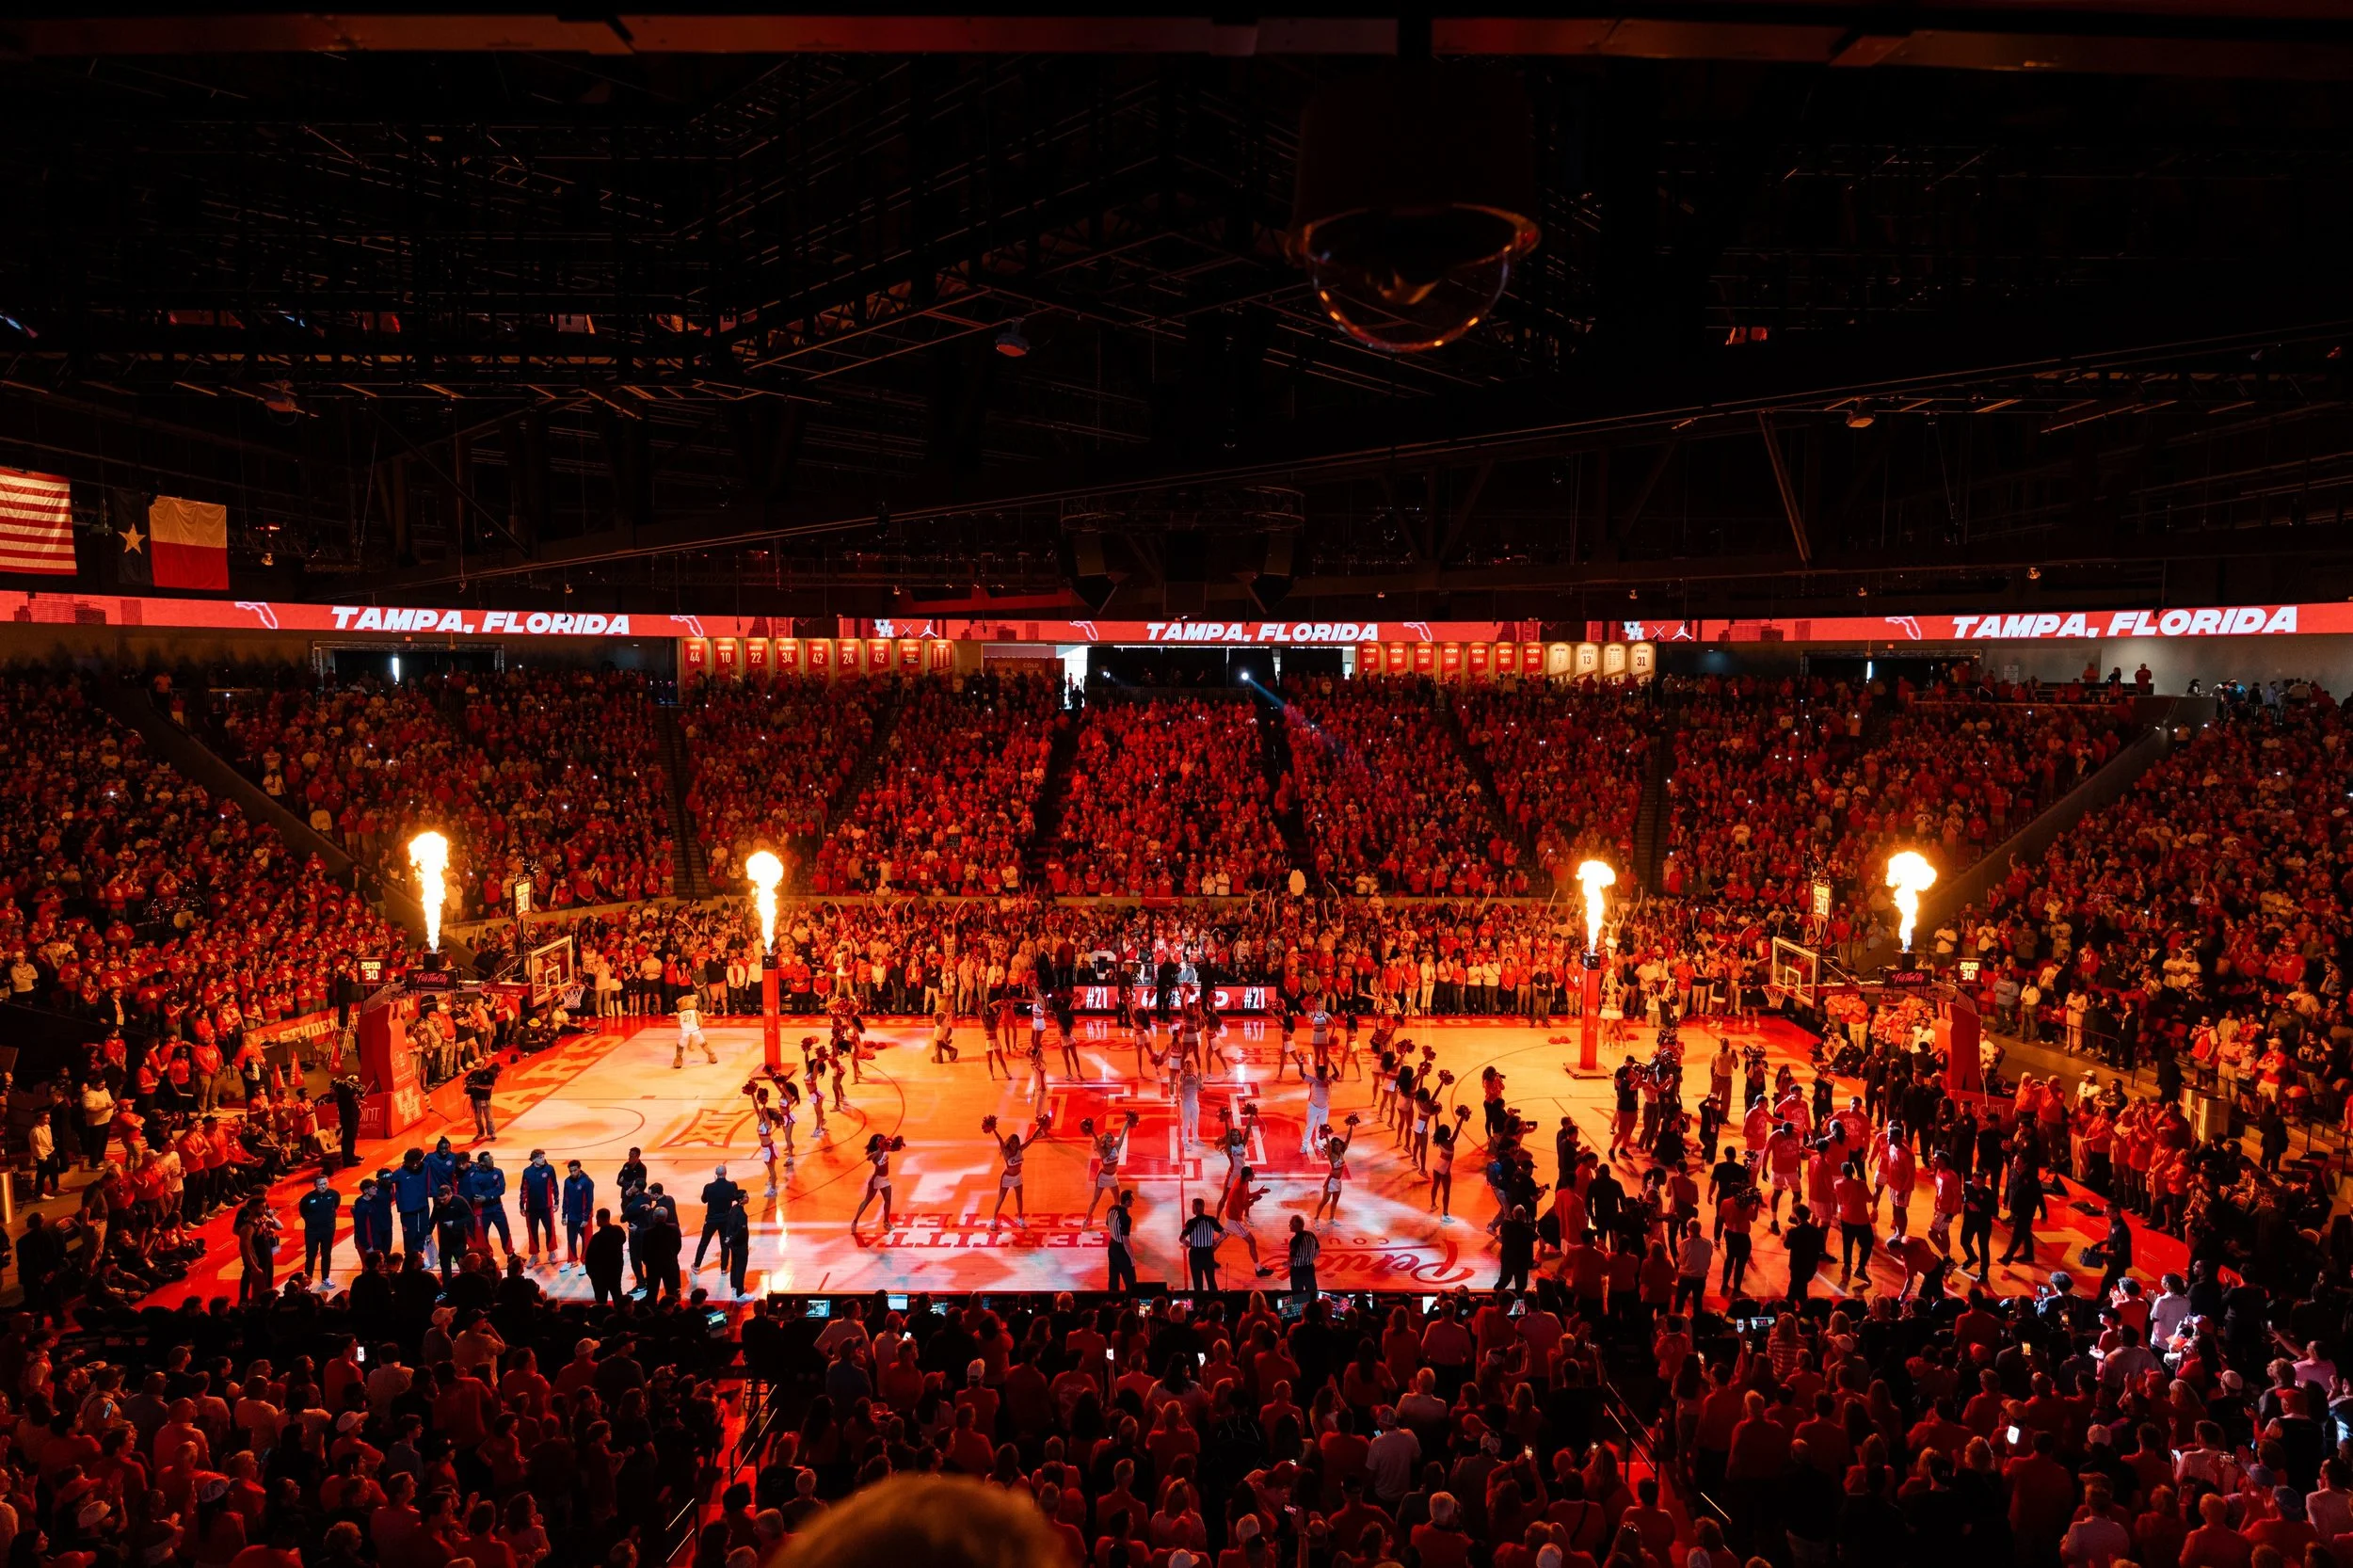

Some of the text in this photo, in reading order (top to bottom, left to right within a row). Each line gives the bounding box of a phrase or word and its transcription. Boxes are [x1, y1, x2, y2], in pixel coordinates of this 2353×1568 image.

[331, 605, 630, 634] TAMPA, FLORIDA
[1952, 606, 2298, 638] TAMPA, FLORIDA
[1145, 622, 1379, 642] TAMPA, FLORIDA
[689, 652, 701, 664] 44
[720, 652, 731, 664] 10
[750, 652, 761, 664] 22
[782, 652, 793, 664] 34
[812, 652, 824, 664] 42
[842, 652, 855, 664] 24
[873, 652, 885, 664] 42
[1582, 656, 1592, 664] 13
[1637, 656, 1646, 666] 31
[1815, 895, 1829, 916] 30
[360, 961, 381, 970] 20:00
[365, 969, 379, 981] 30
[1961, 969, 1976, 981] 30
[1085, 986, 1108, 1009] #21
[1243, 986, 1266, 1009] #21
[681, 1014, 693, 1023] 27
[279, 1016, 339, 1042] STUDEN
[393, 1084, 424, 1126] UH
[851, 1231, 1112, 1248] FERTITTA
[1281, 1237, 1390, 1246] COUT
